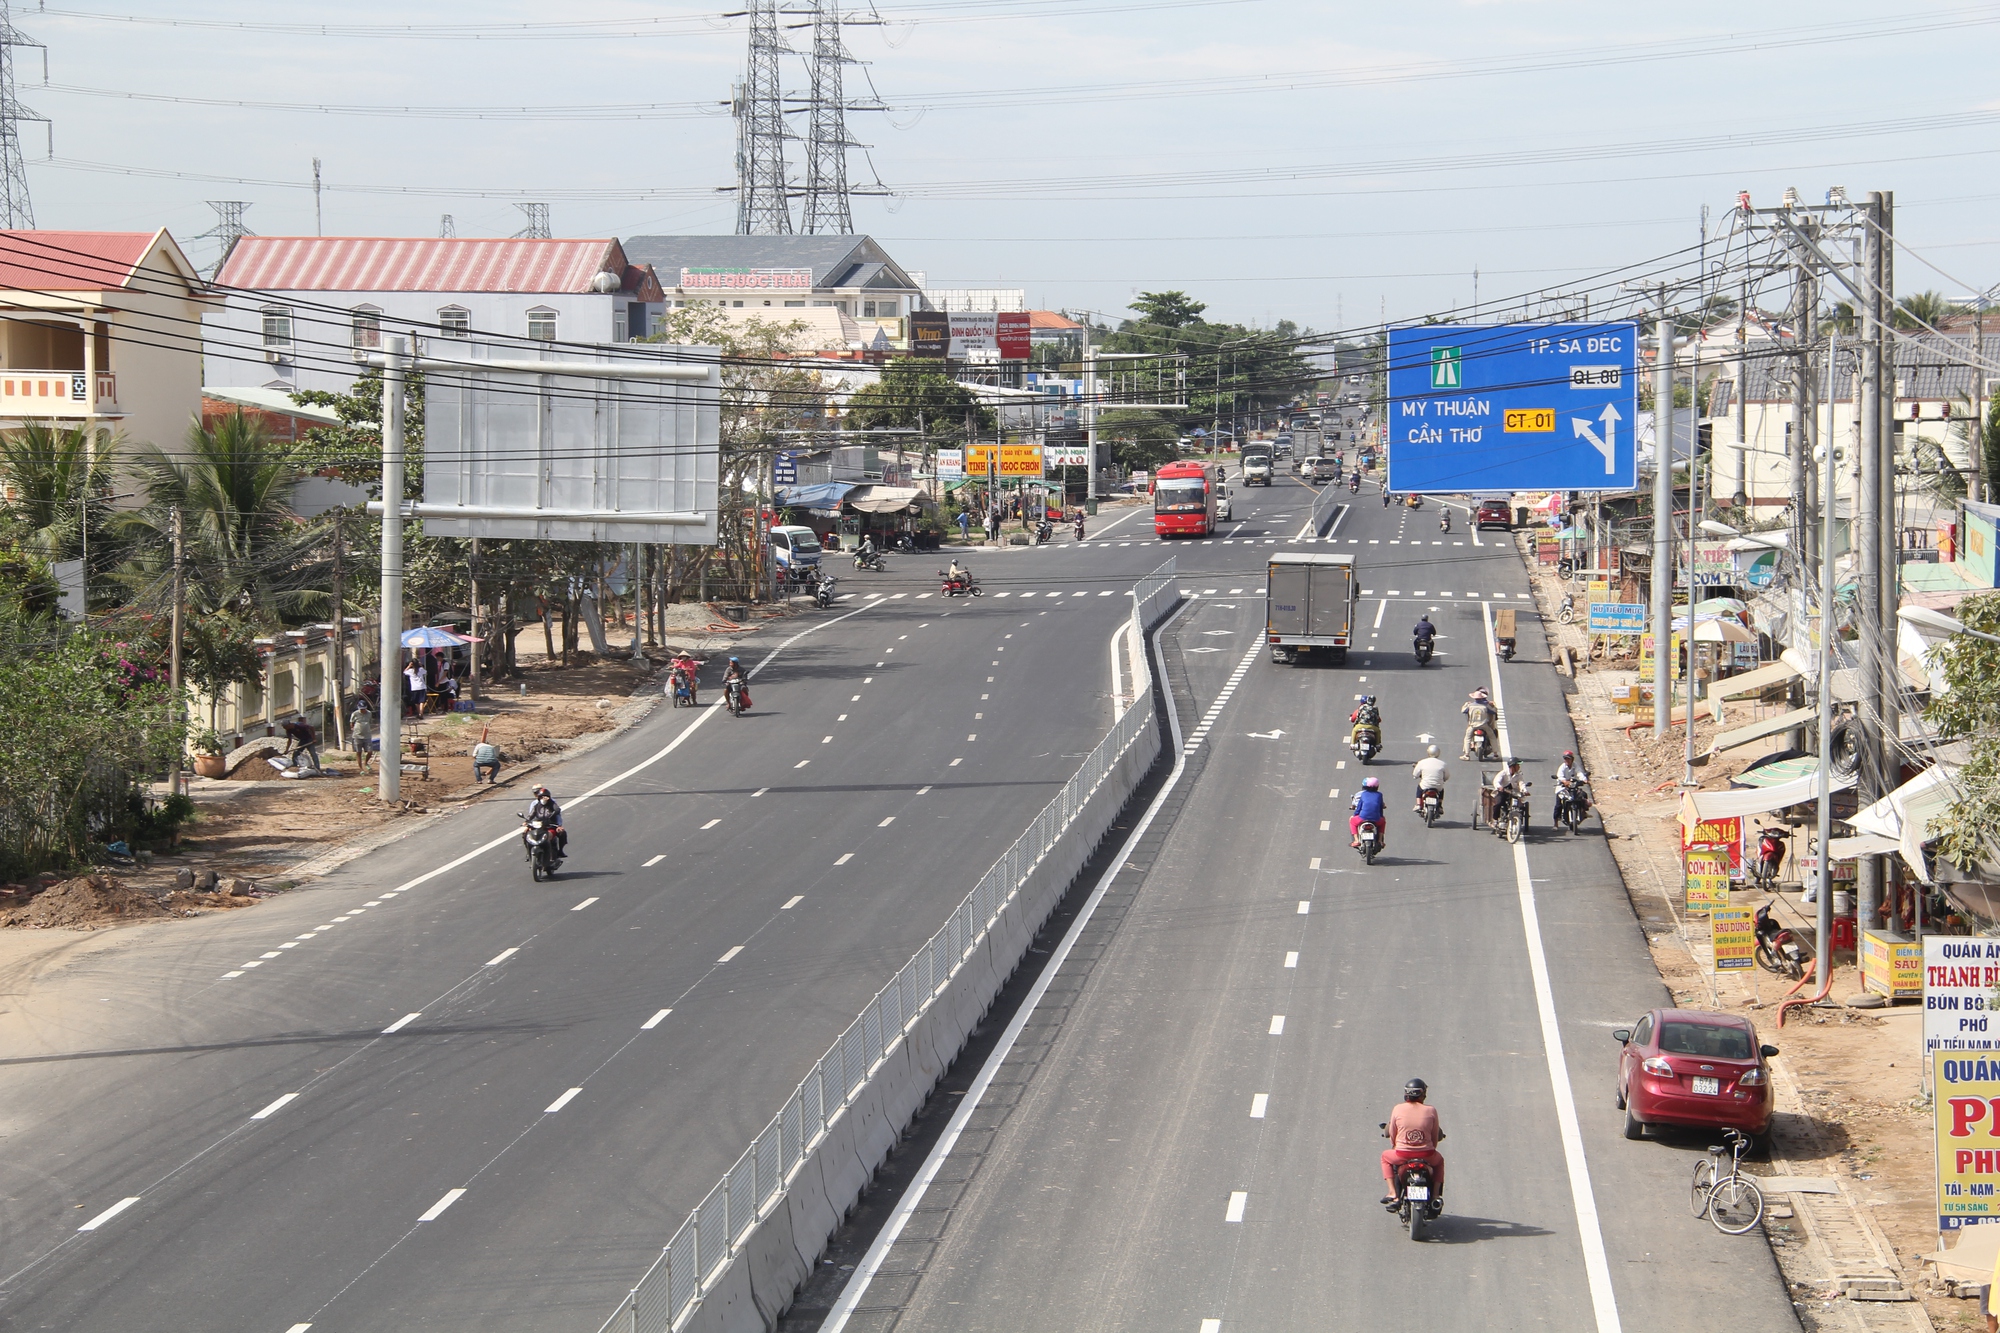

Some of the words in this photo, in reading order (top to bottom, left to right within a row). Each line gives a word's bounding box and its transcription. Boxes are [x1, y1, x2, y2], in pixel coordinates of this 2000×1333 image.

[1527, 339, 1554, 354] TP.
[1559, 337, 1582, 354] SA
[1587, 333, 1622, 353] ĐÉC
[1573, 369, 1619, 385] QL.80
[1434, 397, 1490, 418] THUẬN
[1408, 422, 1442, 444] CẦN
[1449, 426, 1483, 443] THƠ
[969, 462, 986, 473] TỊNH
[1942, 942, 1981, 959] QUÁN
[1894, 957, 1919, 969] SÁU
[1927, 965, 1981, 988] THANH
[1927, 994, 1959, 1010] BÚN
[1963, 994, 1984, 1011] BÒ
[1959, 1014, 1989, 1032] PHỞ
[1944, 1181, 1962, 1196] TÁI
[1970, 1183, 1994, 1198] NẠM
[1955, 1203, 1966, 1211] 5H
[1967, 1202, 1988, 1211] SÁNG
